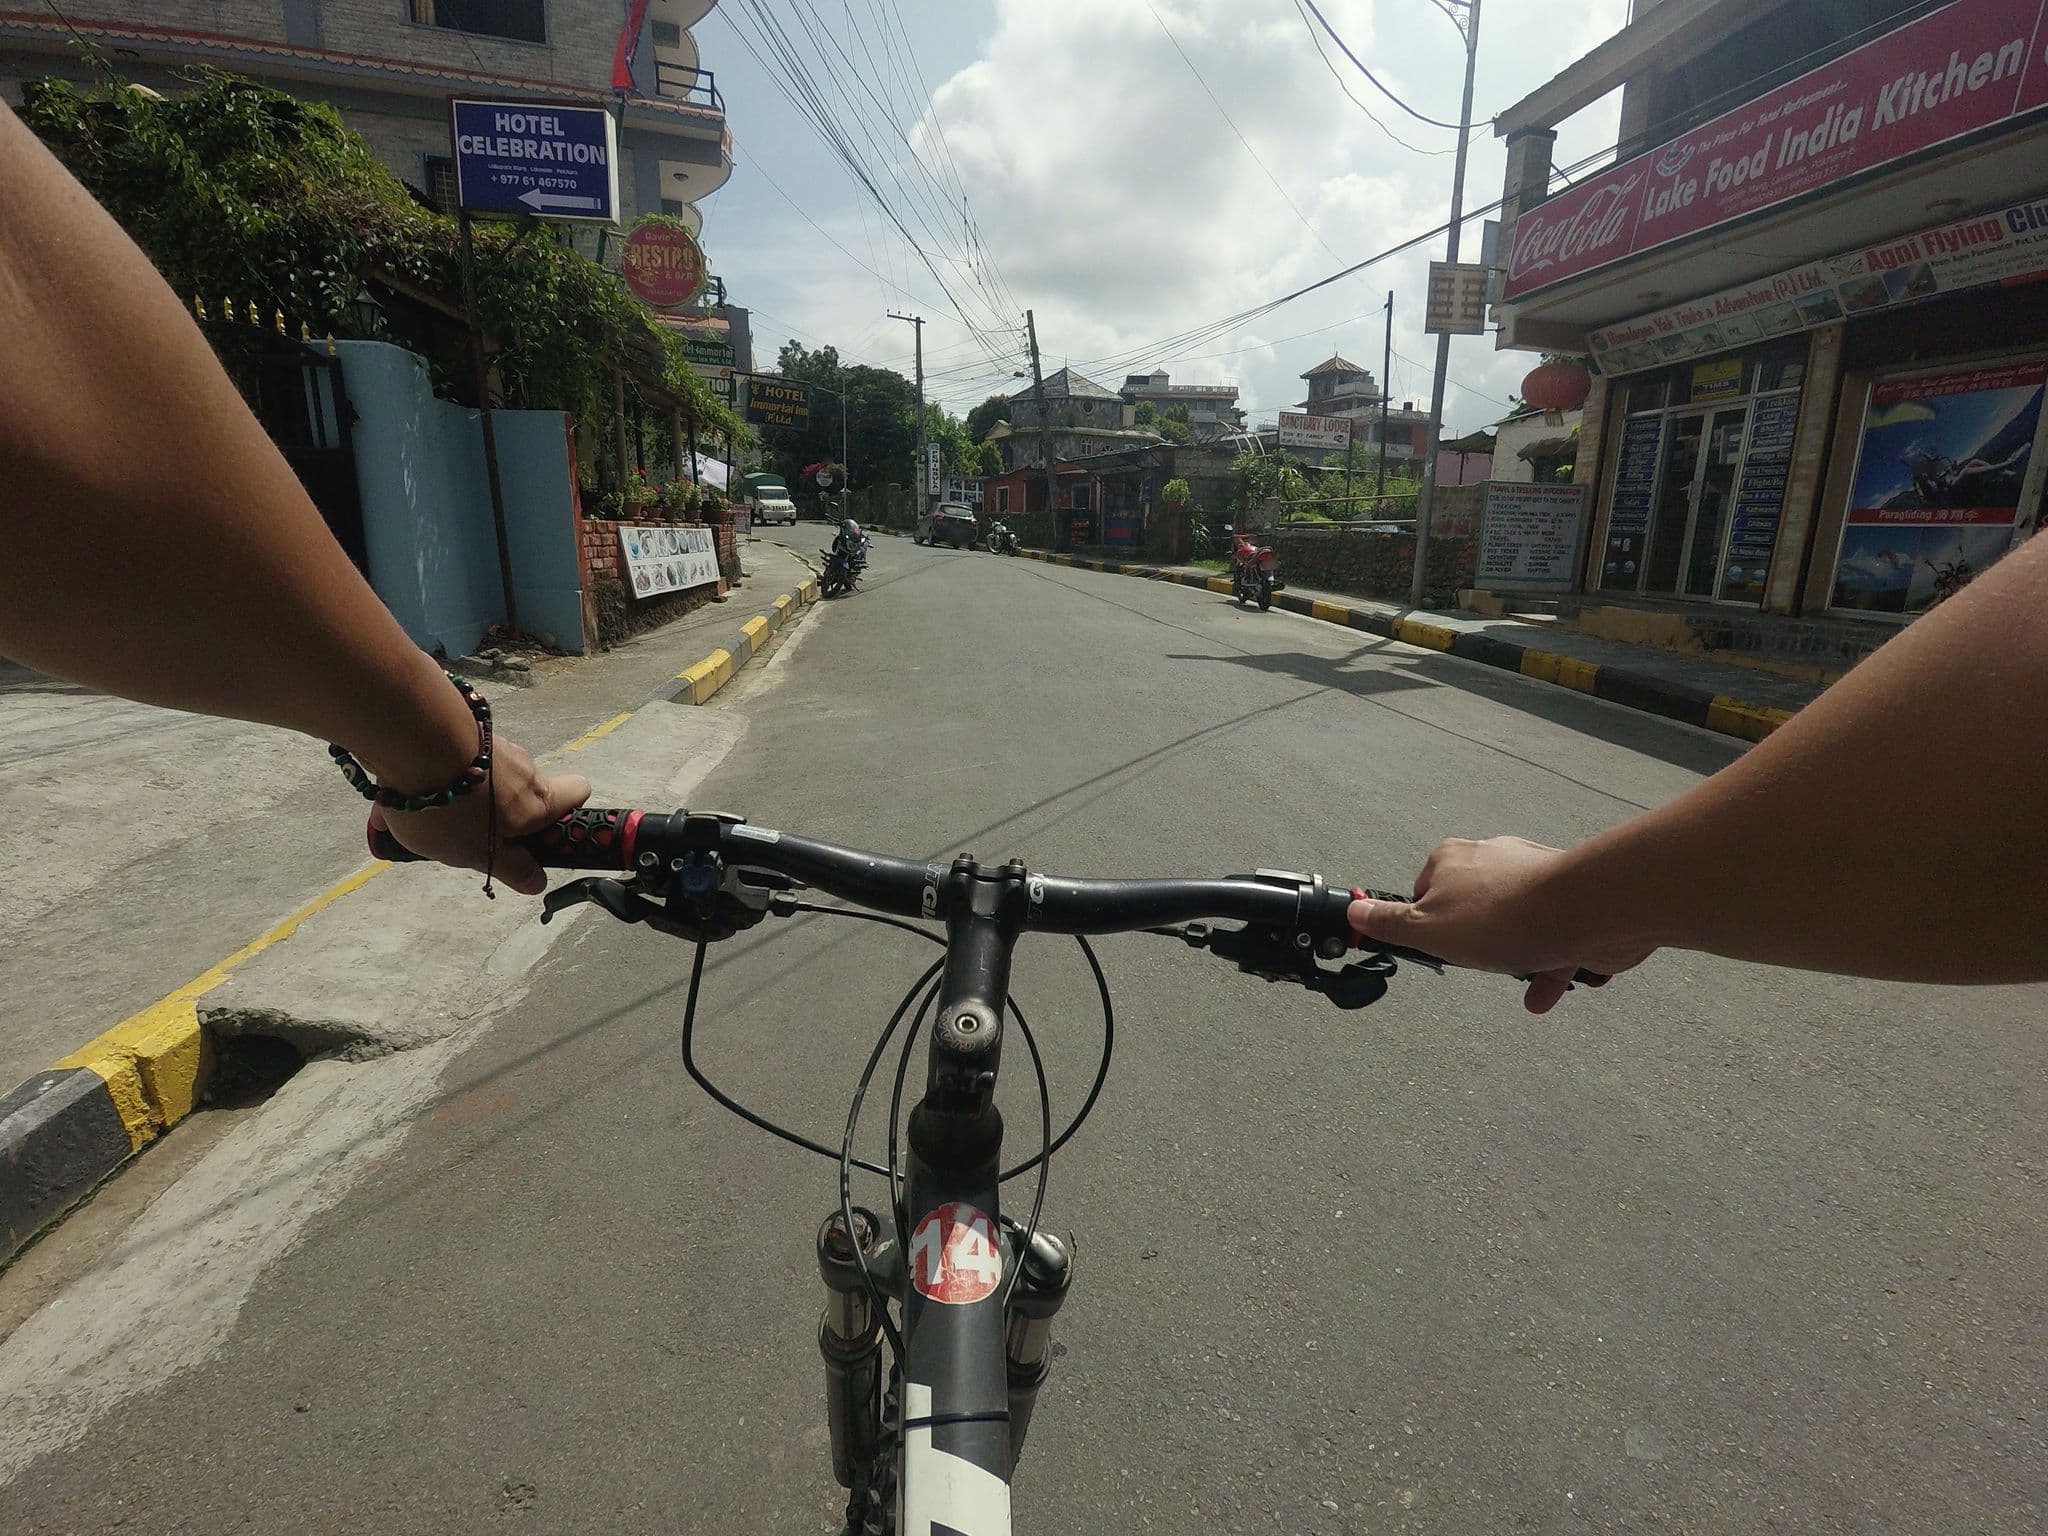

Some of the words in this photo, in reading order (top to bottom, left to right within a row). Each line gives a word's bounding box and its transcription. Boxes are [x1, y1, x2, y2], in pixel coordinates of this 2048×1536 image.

[495, 112, 565, 137] HOTEL
[1643, 175, 1697, 221] Lake
[1703, 133, 1773, 199] Food
[1775, 103, 1864, 170] India
[1872, 37, 2024, 131] Kitchen
[459, 134, 606, 165] CELEBRATION
[500, 174, 519, 185] 977
[522, 176, 535, 187] 61
[538, 177, 577, 189] 467570
[1865, 237, 1921, 272] Agni
[1921, 218, 2004, 255] Flying
[2005, 201, 2048, 233] Clu
[765, 386, 806, 402] HOTEL
[750, 398, 793, 416] Immortal
[1281, 414, 1321, 431] SANCTUARY
[1324, 417, 1350, 433] LODGE
[1878, 509, 1932, 521] Paragliding
[911, 1217, 1000, 1285] 14
